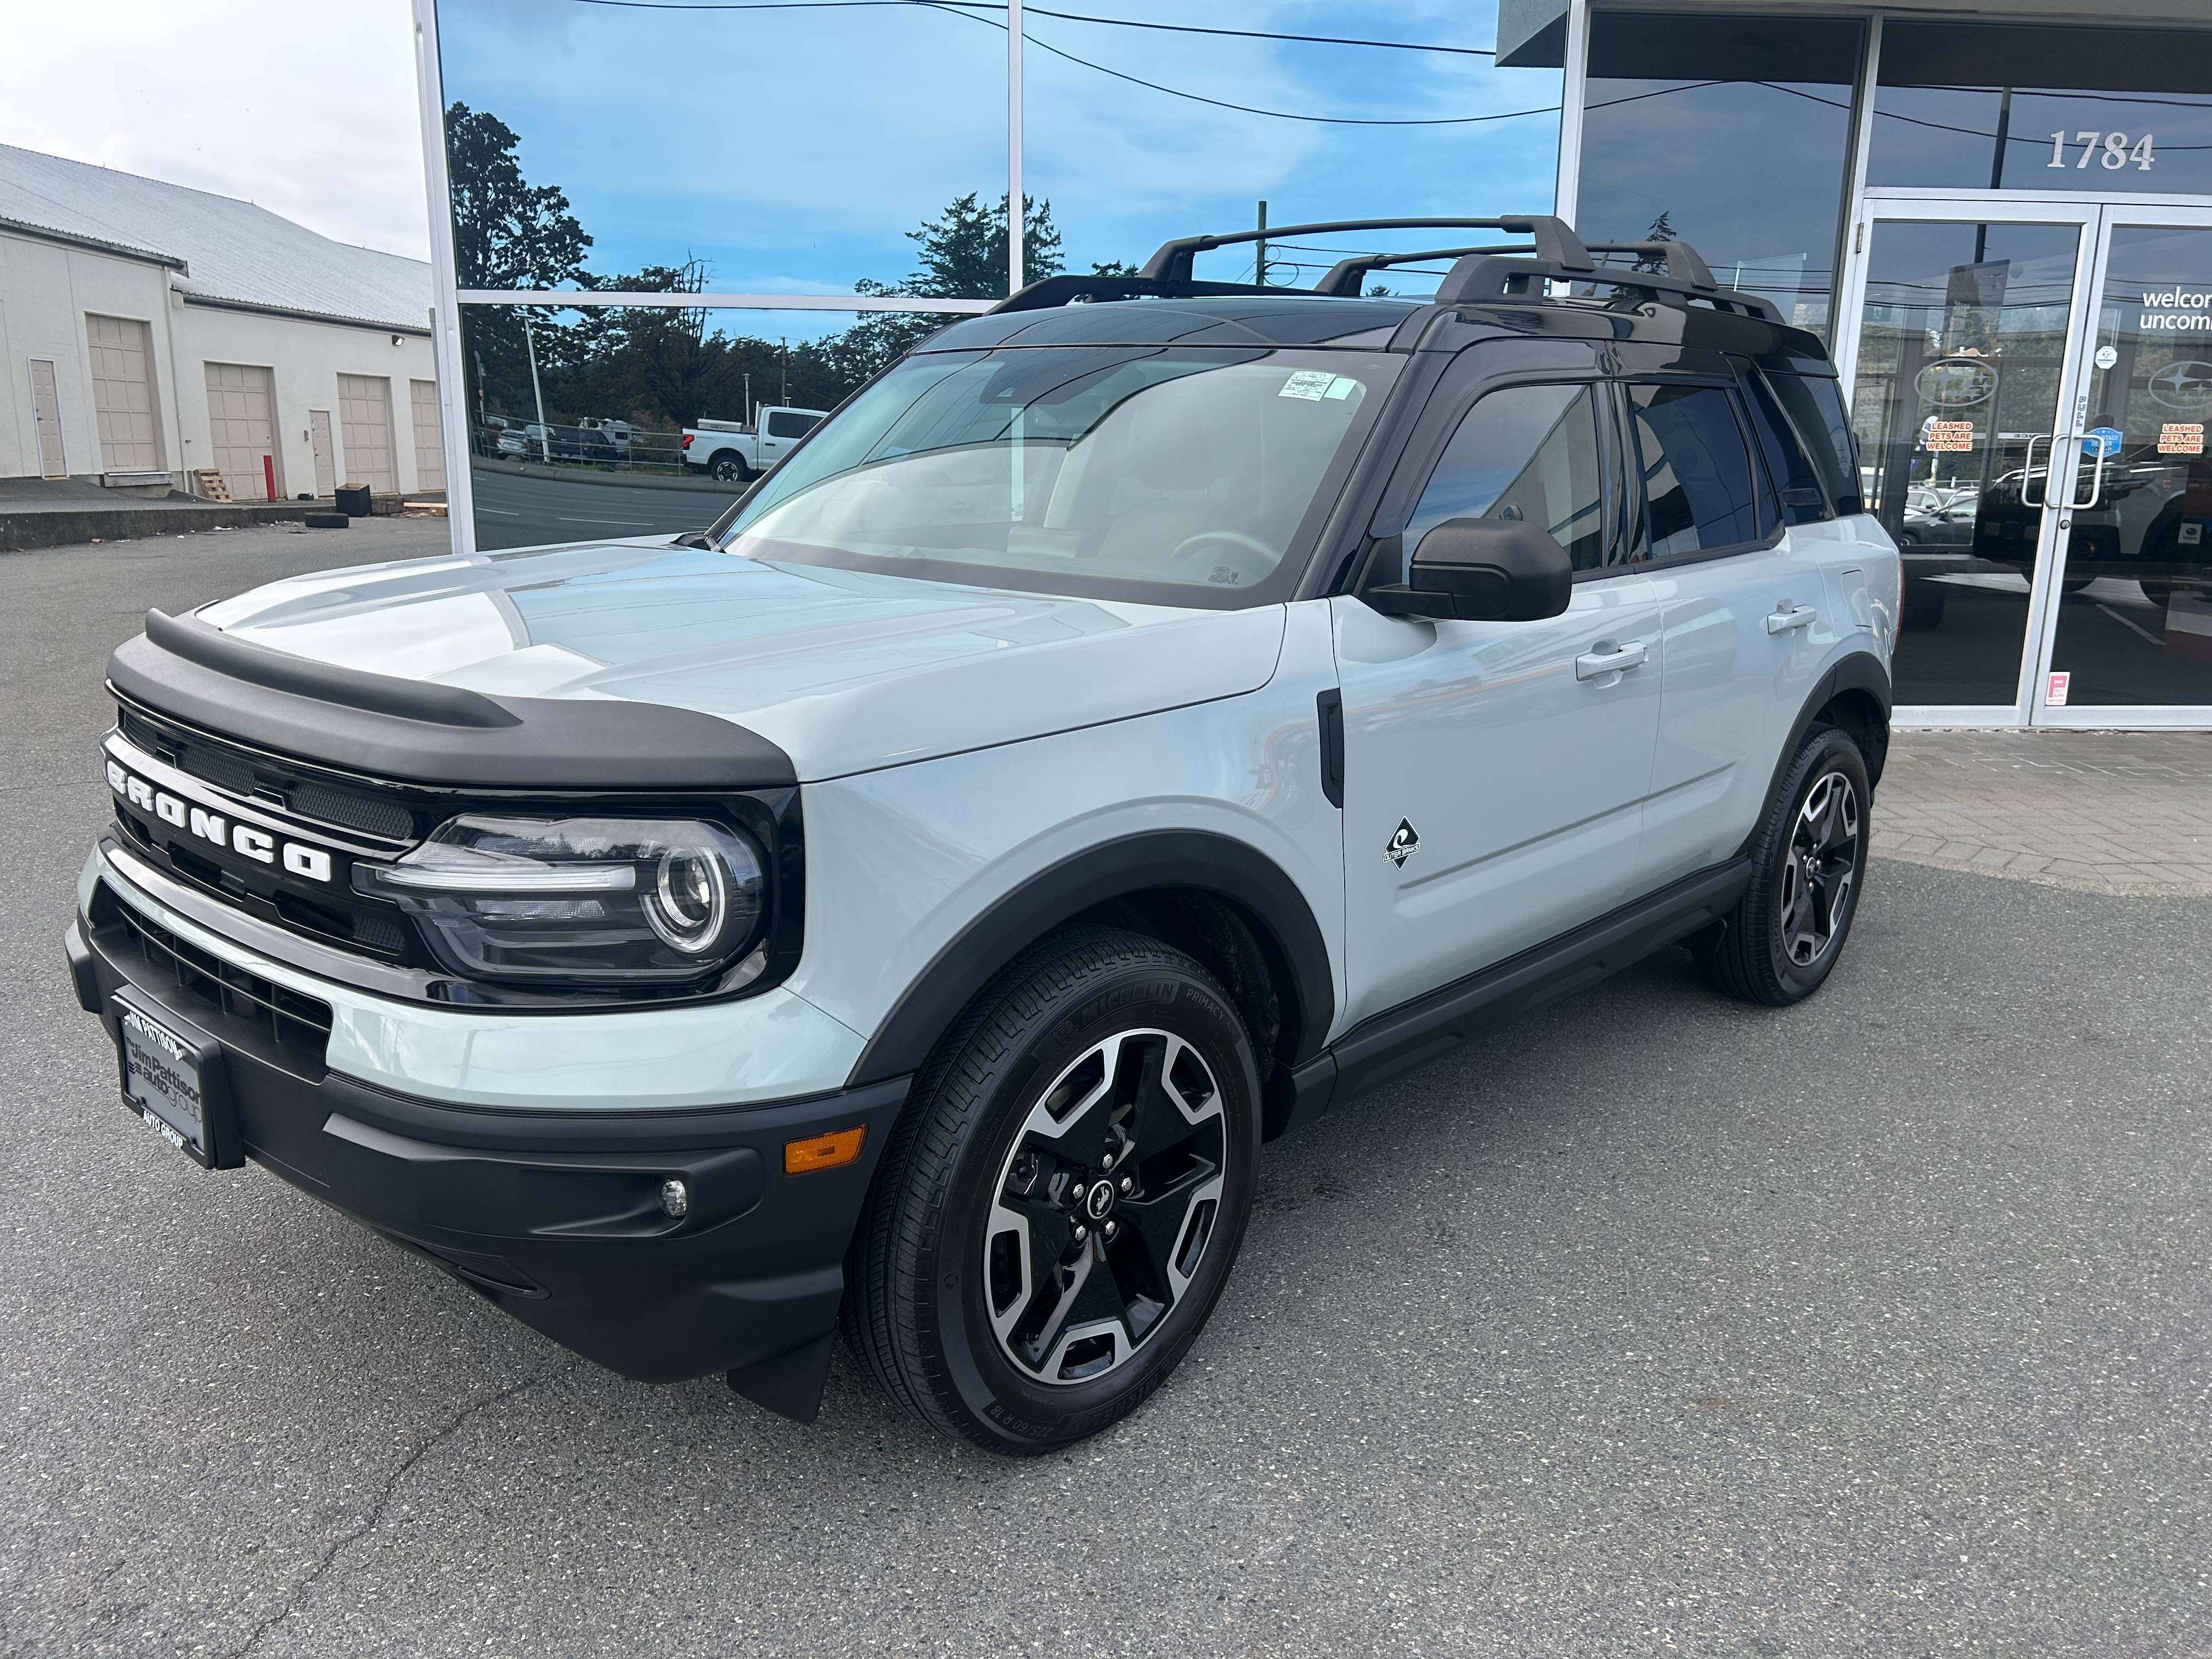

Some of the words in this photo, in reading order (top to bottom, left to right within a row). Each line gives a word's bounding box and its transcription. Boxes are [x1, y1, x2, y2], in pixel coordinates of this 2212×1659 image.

[2046, 130, 2155, 171] 1784
[2140, 314, 2212, 330] uncom
[2075, 396, 2087, 427] PULL
[106, 760, 331, 882] BRONCO
[1384, 850, 1401, 861] OUTER
[1402, 844, 1419, 855] BANKS
[1081, 982, 1175, 1025] MICHELIN
[1186, 988, 1225, 1020] PRIMACY
[143, 1110, 161, 1132] AUTO
[161, 1122, 184, 1149] GROUP
[990, 1405, 1005, 1419] 18
[1002, 1413, 1014, 1425] R
